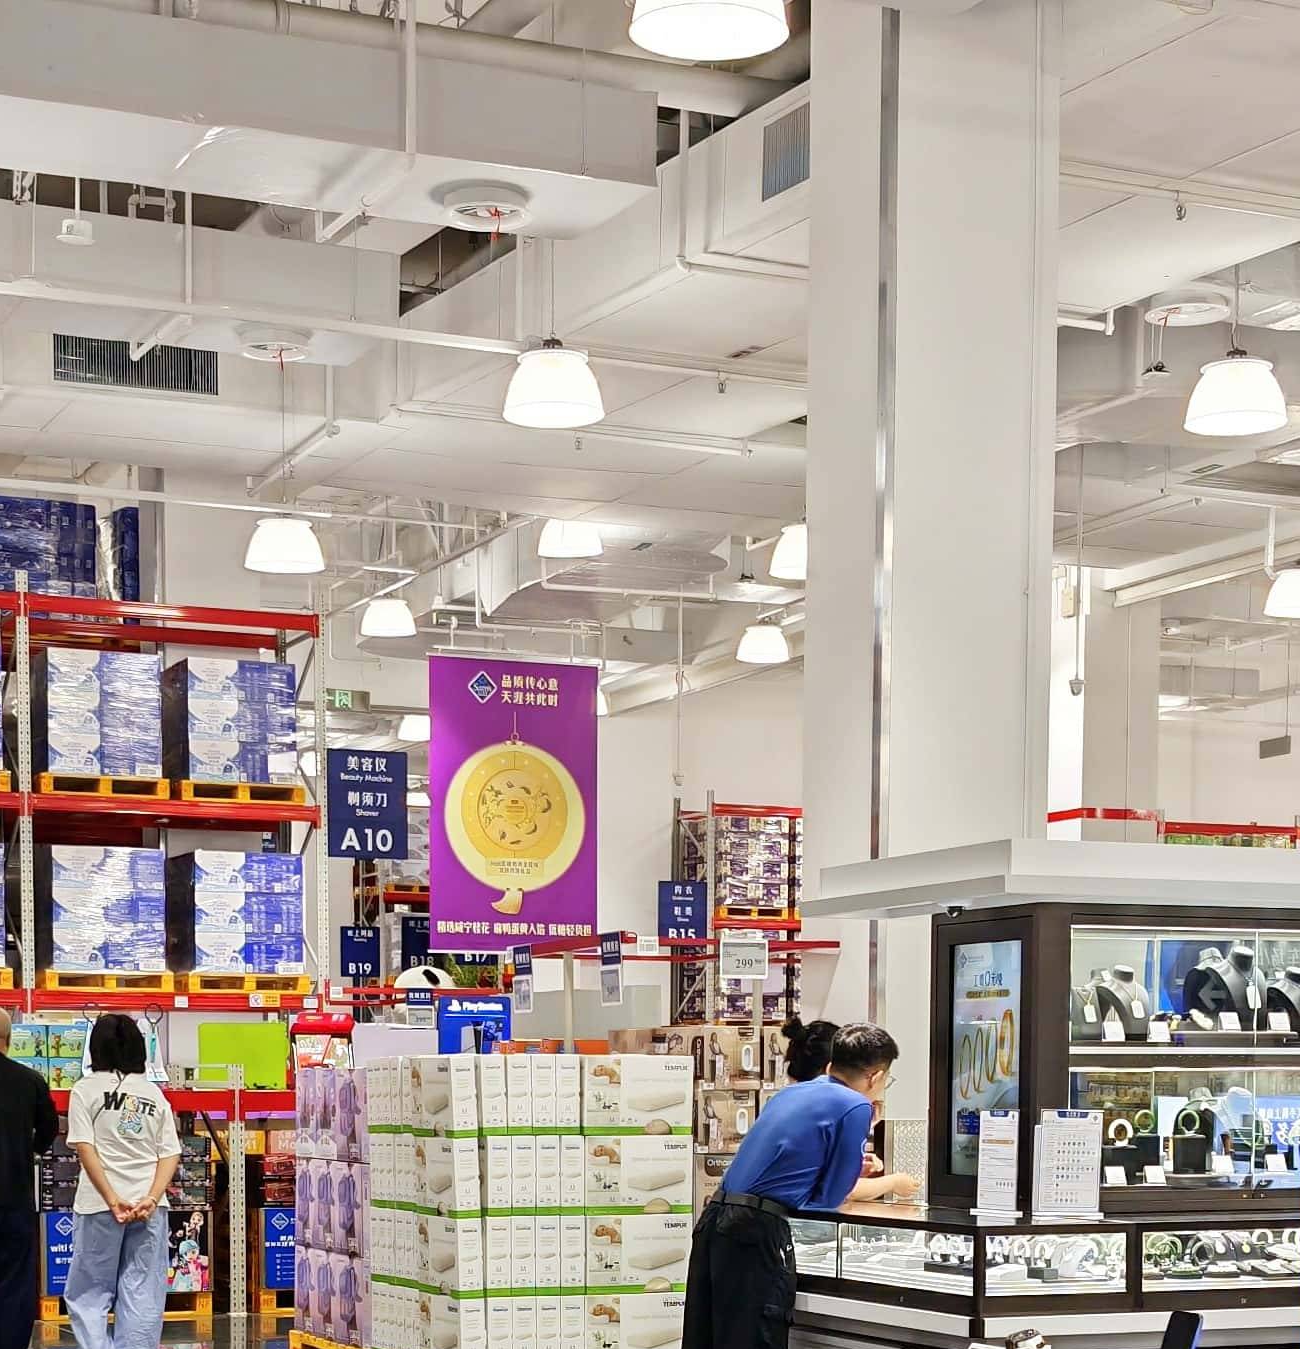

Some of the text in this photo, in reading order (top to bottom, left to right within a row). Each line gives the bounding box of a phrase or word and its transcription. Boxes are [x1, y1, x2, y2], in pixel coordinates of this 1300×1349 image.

[502, 674, 559, 691] 品质传心意
[502, 690, 558, 707] 天涯共此时
[347, 756, 387, 772] 美容仪
[340, 772, 393, 783] Beauty Machine
[347, 791, 387, 807] 剃须刀
[355, 809, 379, 817] Shaver
[340, 828, 393, 852] A10
[668, 928, 696, 939] B15
[410, 956, 435, 967] B18
[735, 958, 753, 969] 299
[348, 963, 372, 975] B19
